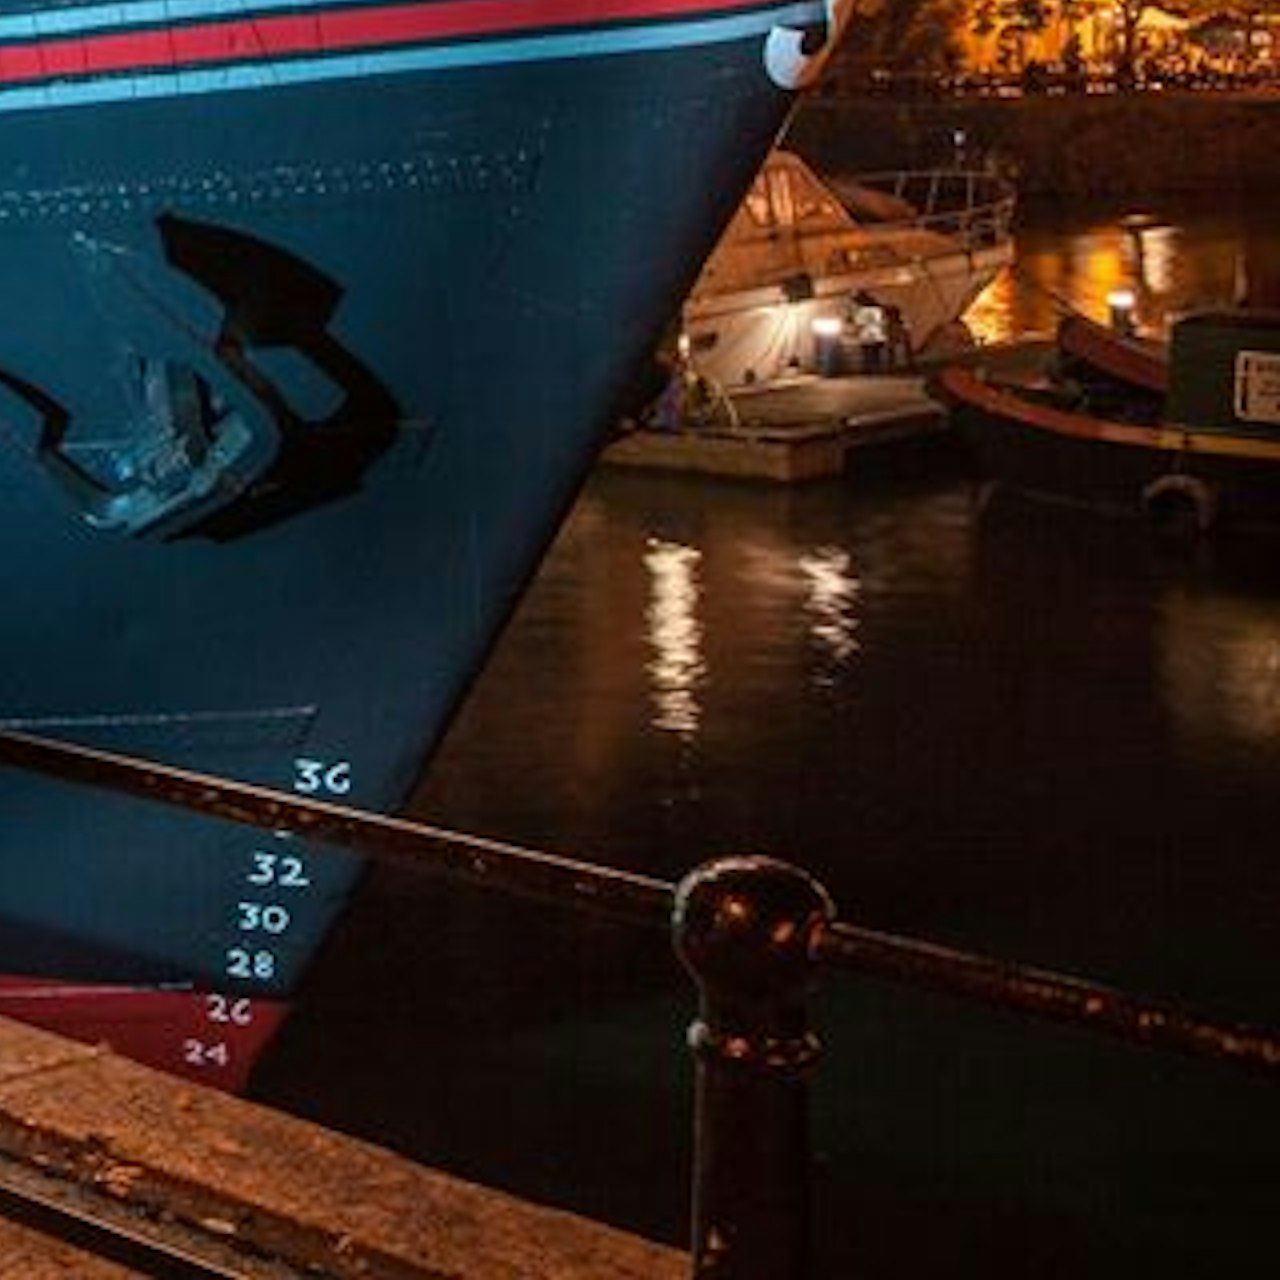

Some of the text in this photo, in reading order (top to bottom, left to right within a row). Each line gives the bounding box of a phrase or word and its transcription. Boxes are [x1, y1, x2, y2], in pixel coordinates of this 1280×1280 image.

[293, 758, 351, 795] 36
[247, 851, 309, 886] 32
[238, 902, 290, 934] 30
[226, 950, 275, 979] 28
[206, 994, 252, 1025] 26
[186, 1039, 228, 1066] 24
